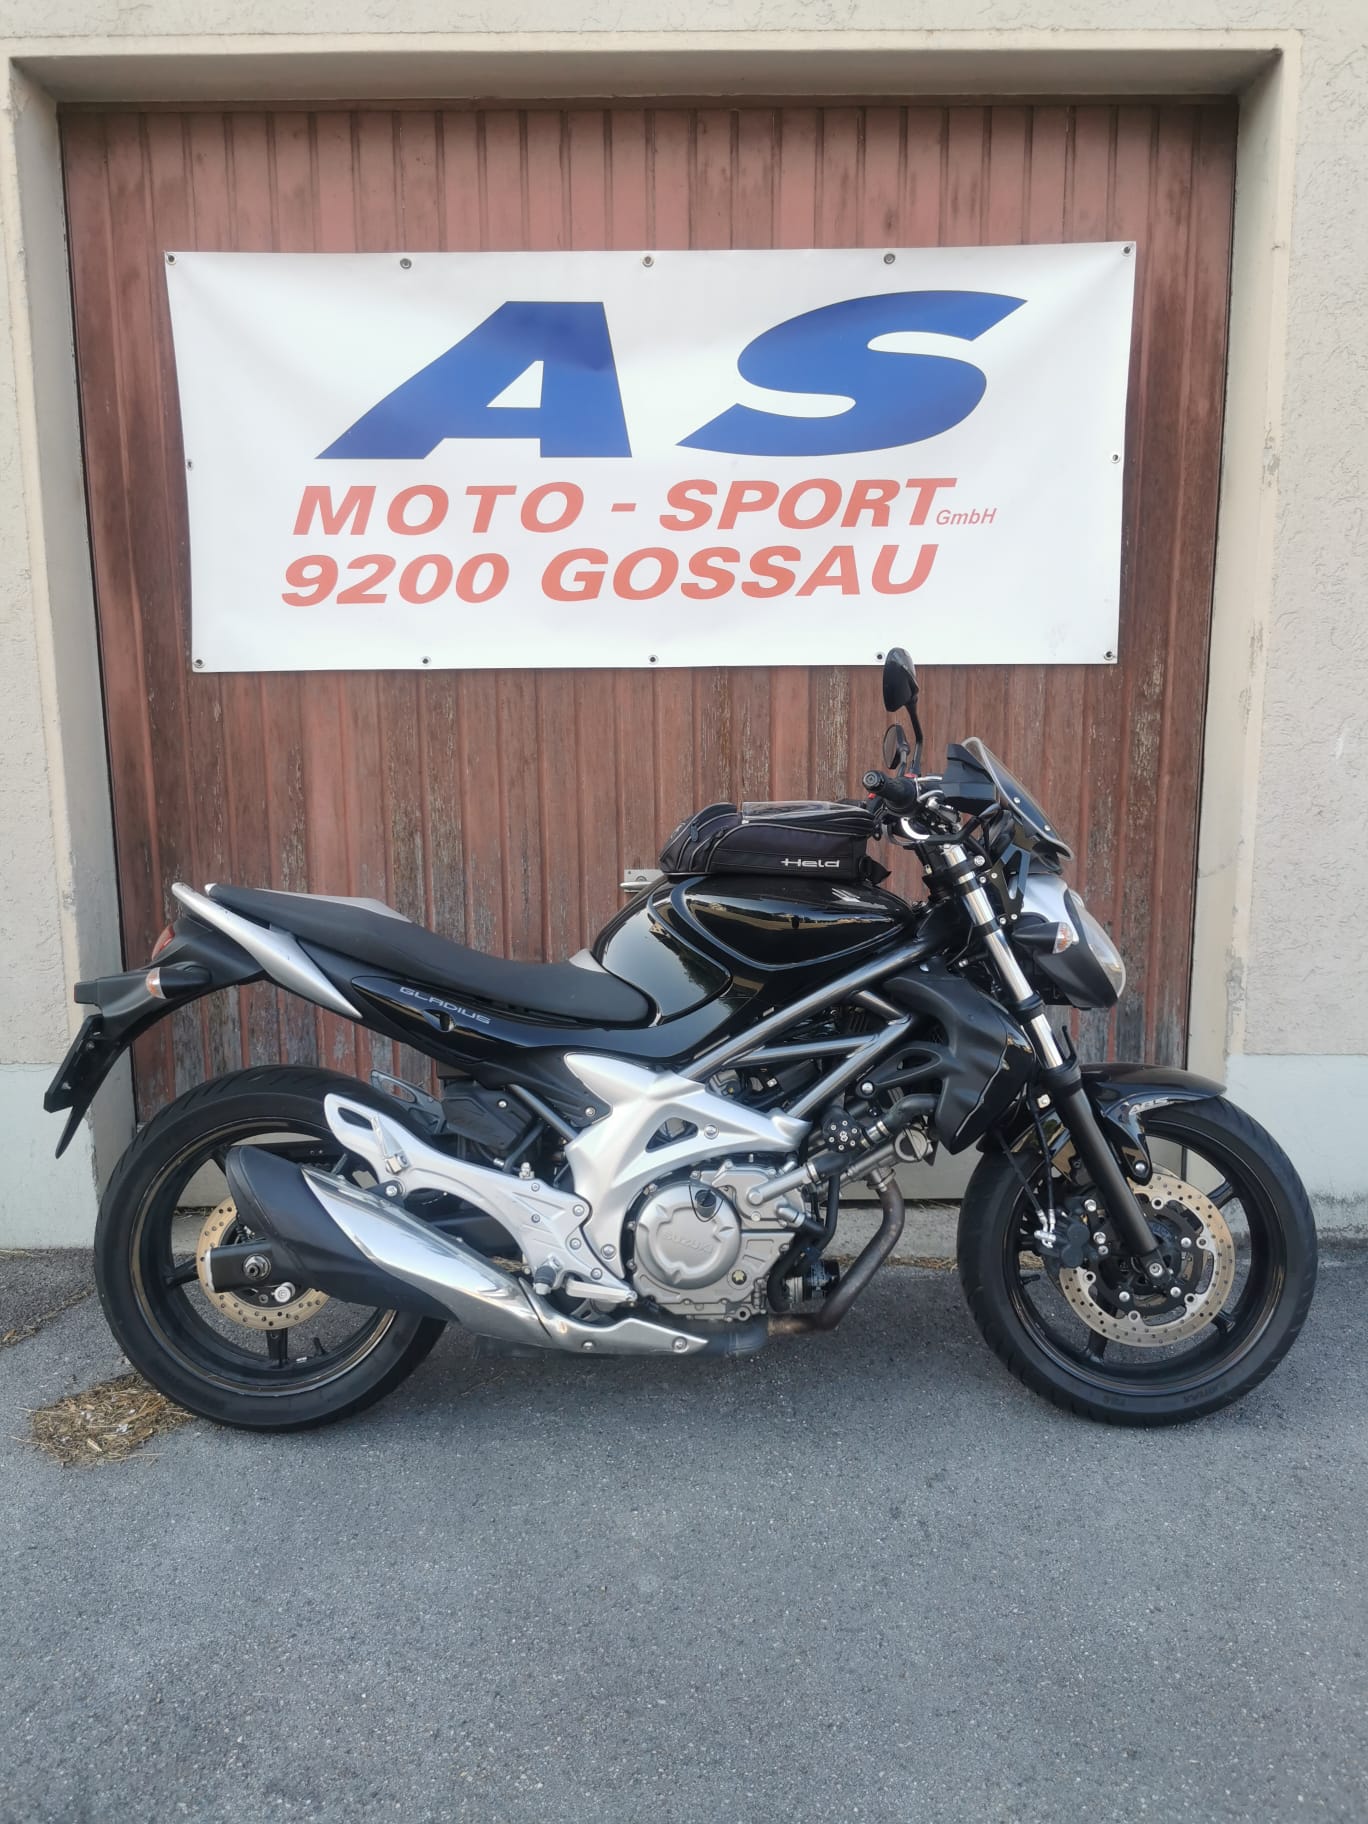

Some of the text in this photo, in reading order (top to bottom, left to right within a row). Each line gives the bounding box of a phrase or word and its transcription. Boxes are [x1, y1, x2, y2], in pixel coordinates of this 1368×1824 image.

[314, 290, 1028, 459] AS
[294, 477, 998, 536] MOTO - SPORT GmbH
[281, 543, 938, 608] 9200 GOSSAU
[780, 857, 840, 868] Held
[399, 986, 492, 1025] GLADIUS
